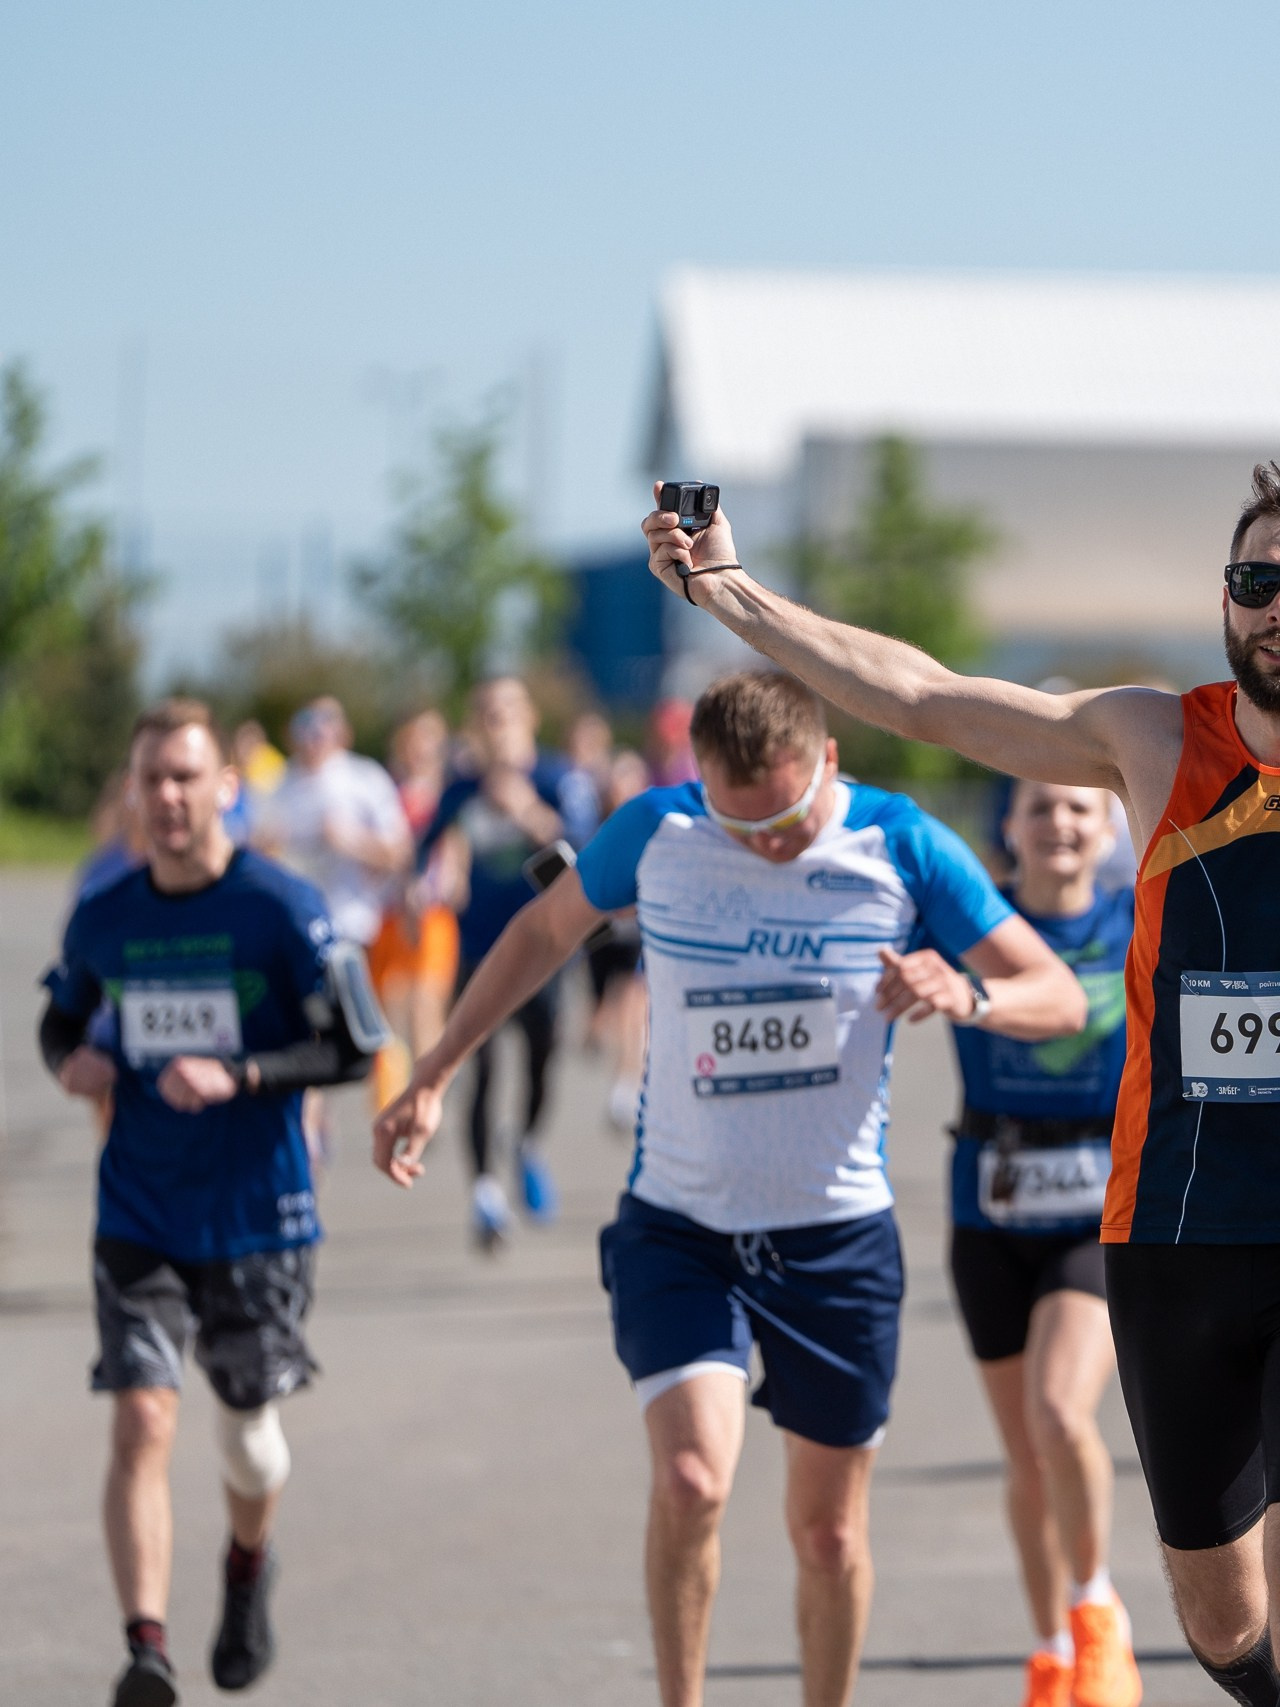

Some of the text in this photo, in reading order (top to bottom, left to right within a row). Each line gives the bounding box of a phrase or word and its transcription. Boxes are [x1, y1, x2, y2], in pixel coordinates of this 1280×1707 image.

[747, 929, 826, 960] RUN
[1188, 979, 1196, 987] 10
[712, 1014, 811, 1055] 8486
